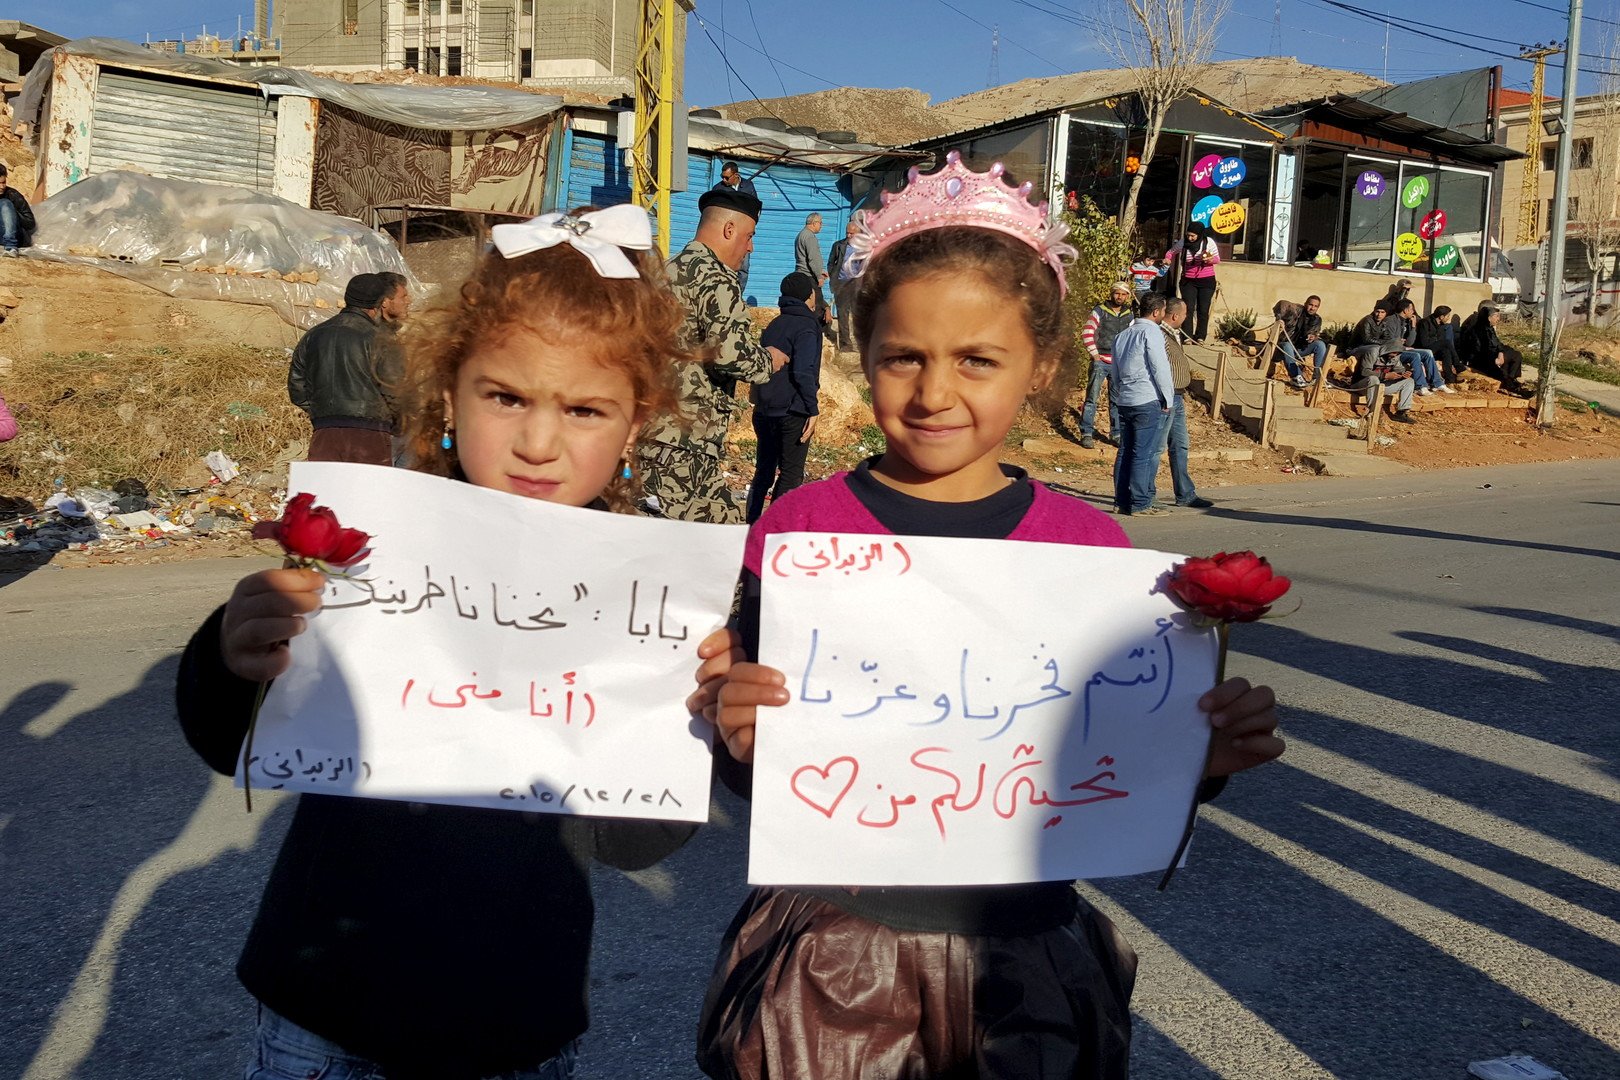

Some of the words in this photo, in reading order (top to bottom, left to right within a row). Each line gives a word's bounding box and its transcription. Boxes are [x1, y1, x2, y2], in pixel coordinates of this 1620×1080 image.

[1215, 215, 1242, 232] فيلادلفيا
[1218, 203, 1237, 217] فاهيتا
[1434, 245, 1457, 268] شاورما
[628, 579, 688, 651] بابا
[961, 643, 1072, 742] فخرنا
[857, 783, 917, 828] من
[911, 746, 986, 843] لكم
